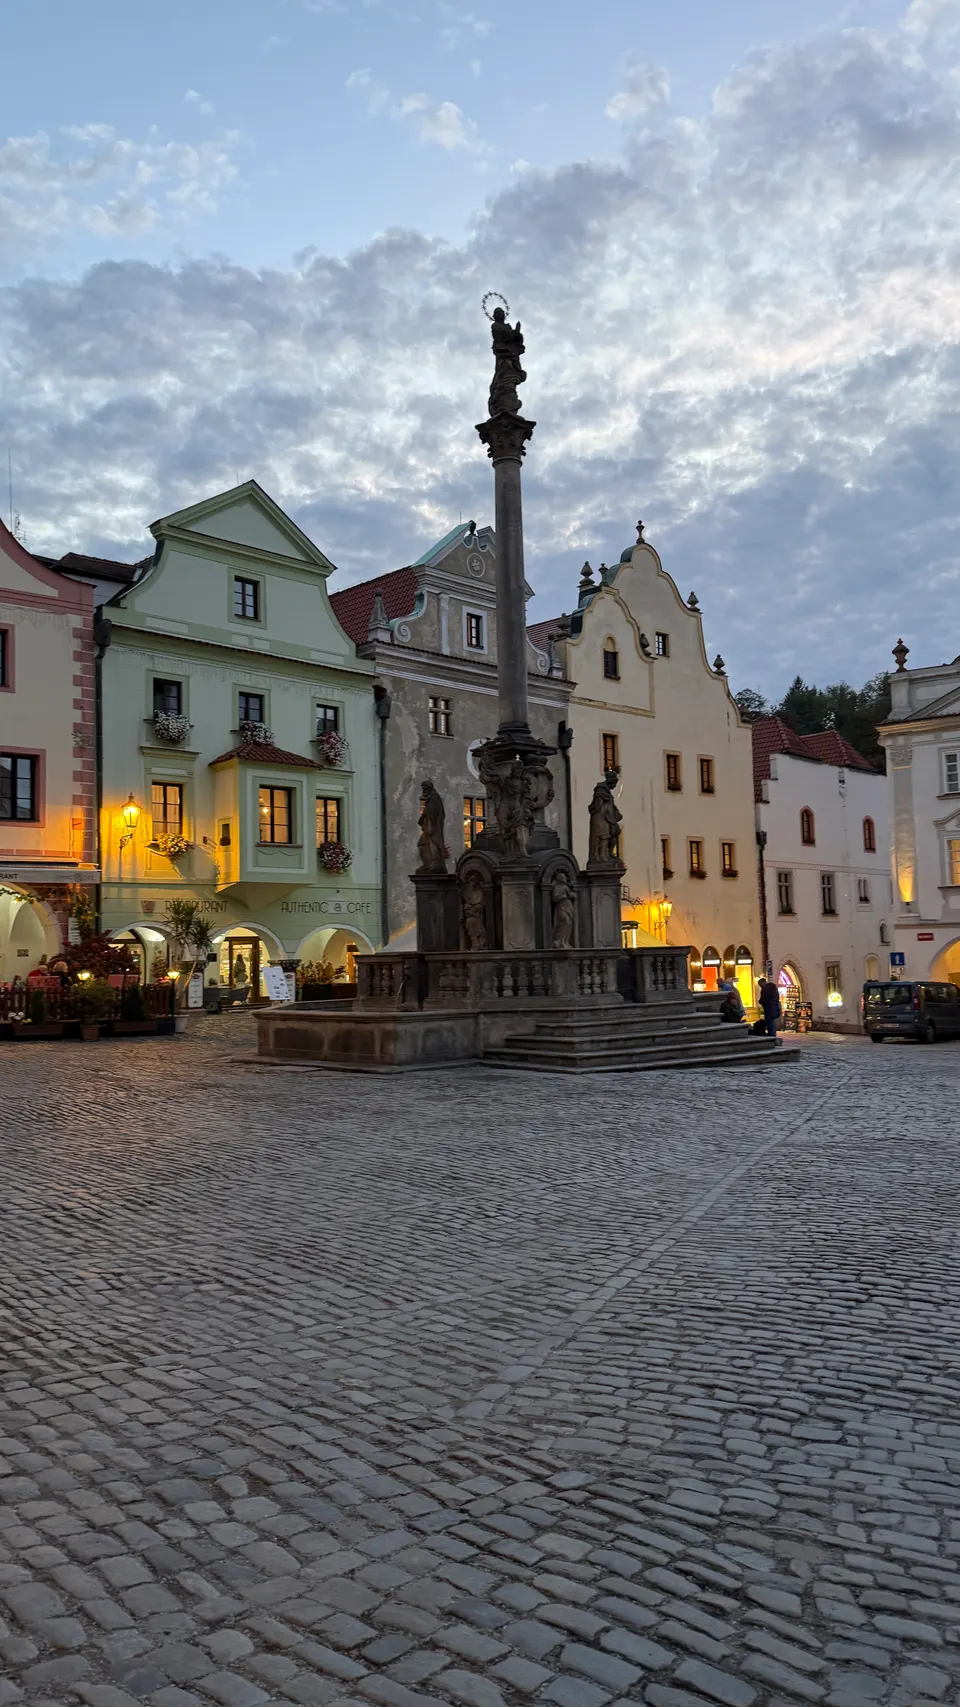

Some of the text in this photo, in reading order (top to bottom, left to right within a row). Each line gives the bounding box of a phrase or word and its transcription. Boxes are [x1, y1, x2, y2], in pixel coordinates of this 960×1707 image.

[165, 900, 229, 913] RTAURANT
[281, 901, 328, 913] AUTHENTIC
[347, 902, 371, 914] CAFE
